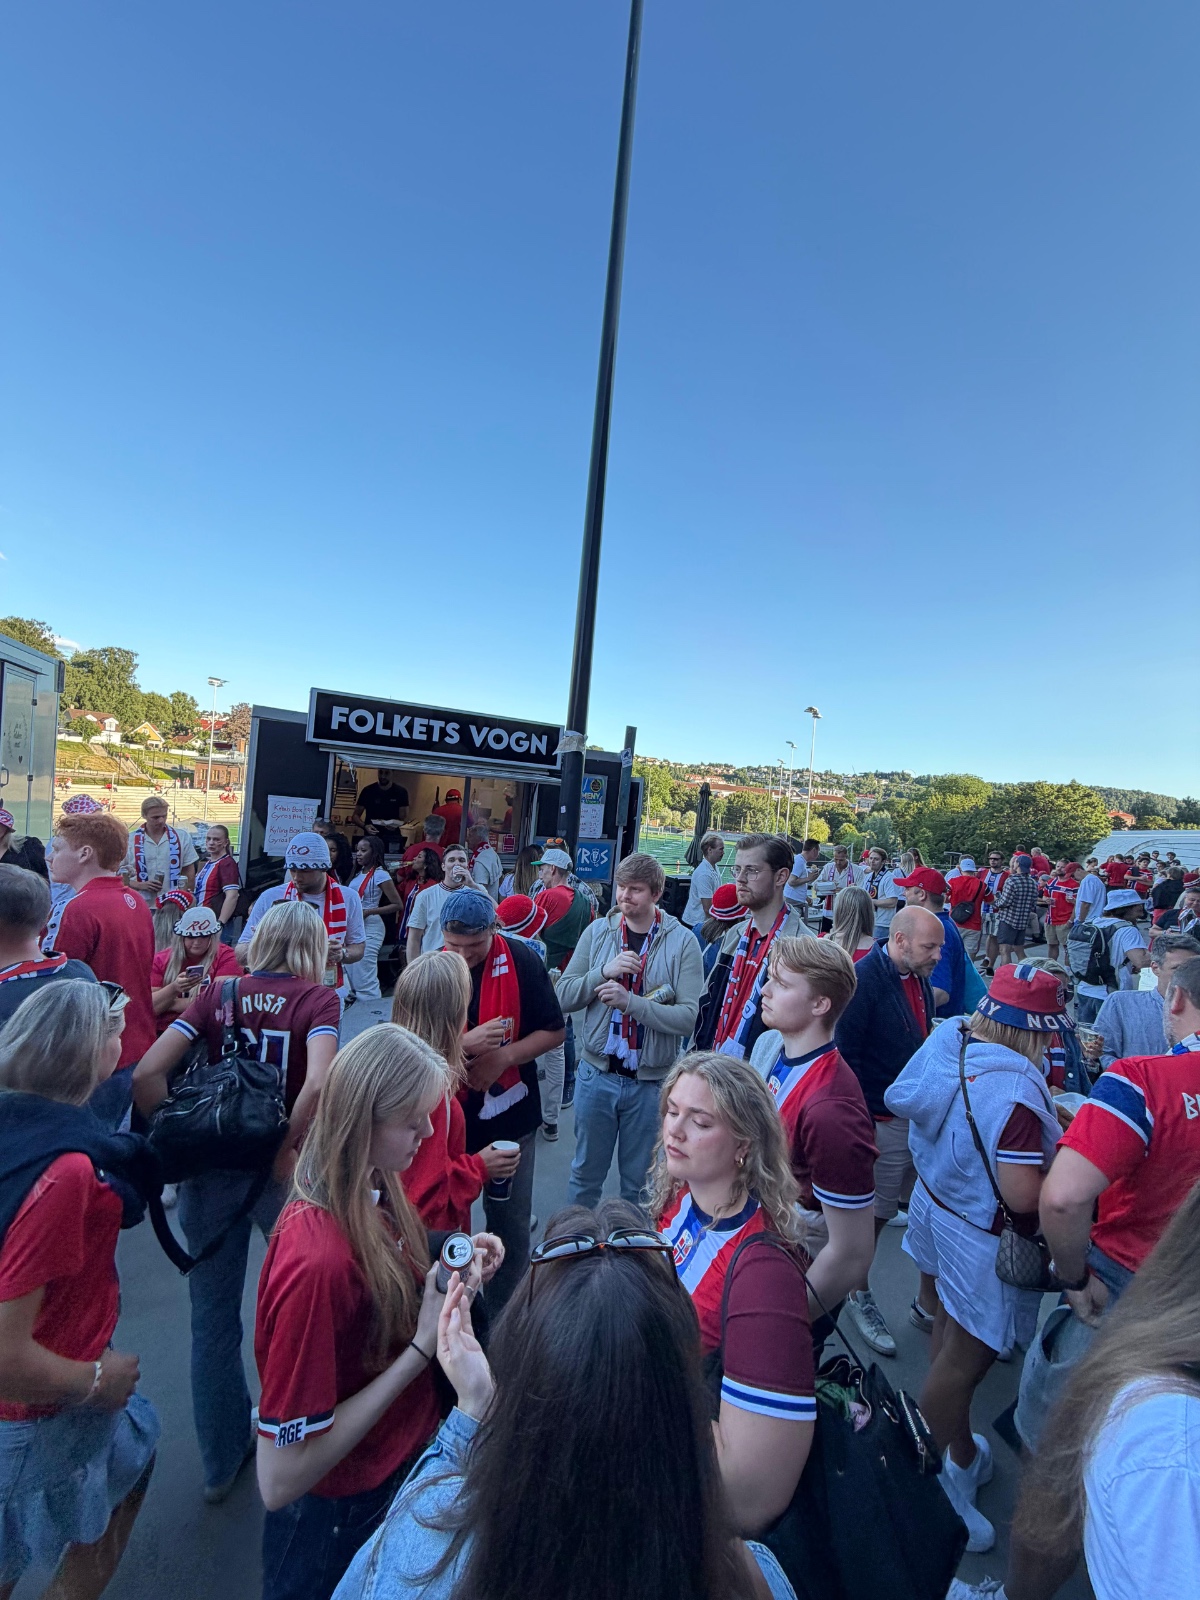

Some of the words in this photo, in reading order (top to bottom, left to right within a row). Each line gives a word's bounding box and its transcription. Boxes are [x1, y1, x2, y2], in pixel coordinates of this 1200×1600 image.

[331, 706, 461, 745] FOLKETS
[469, 724, 548, 756] VOGN
[169, 826, 181, 880] NORG
[287, 844, 310, 856] RO
[186, 919, 211, 931] RO
[977, 995, 1002, 1015] AY
[1026, 1012, 1075, 1030] NOR
[1181, 1092, 1200, 1120] B
[275, 1421, 304, 1447] RGE
